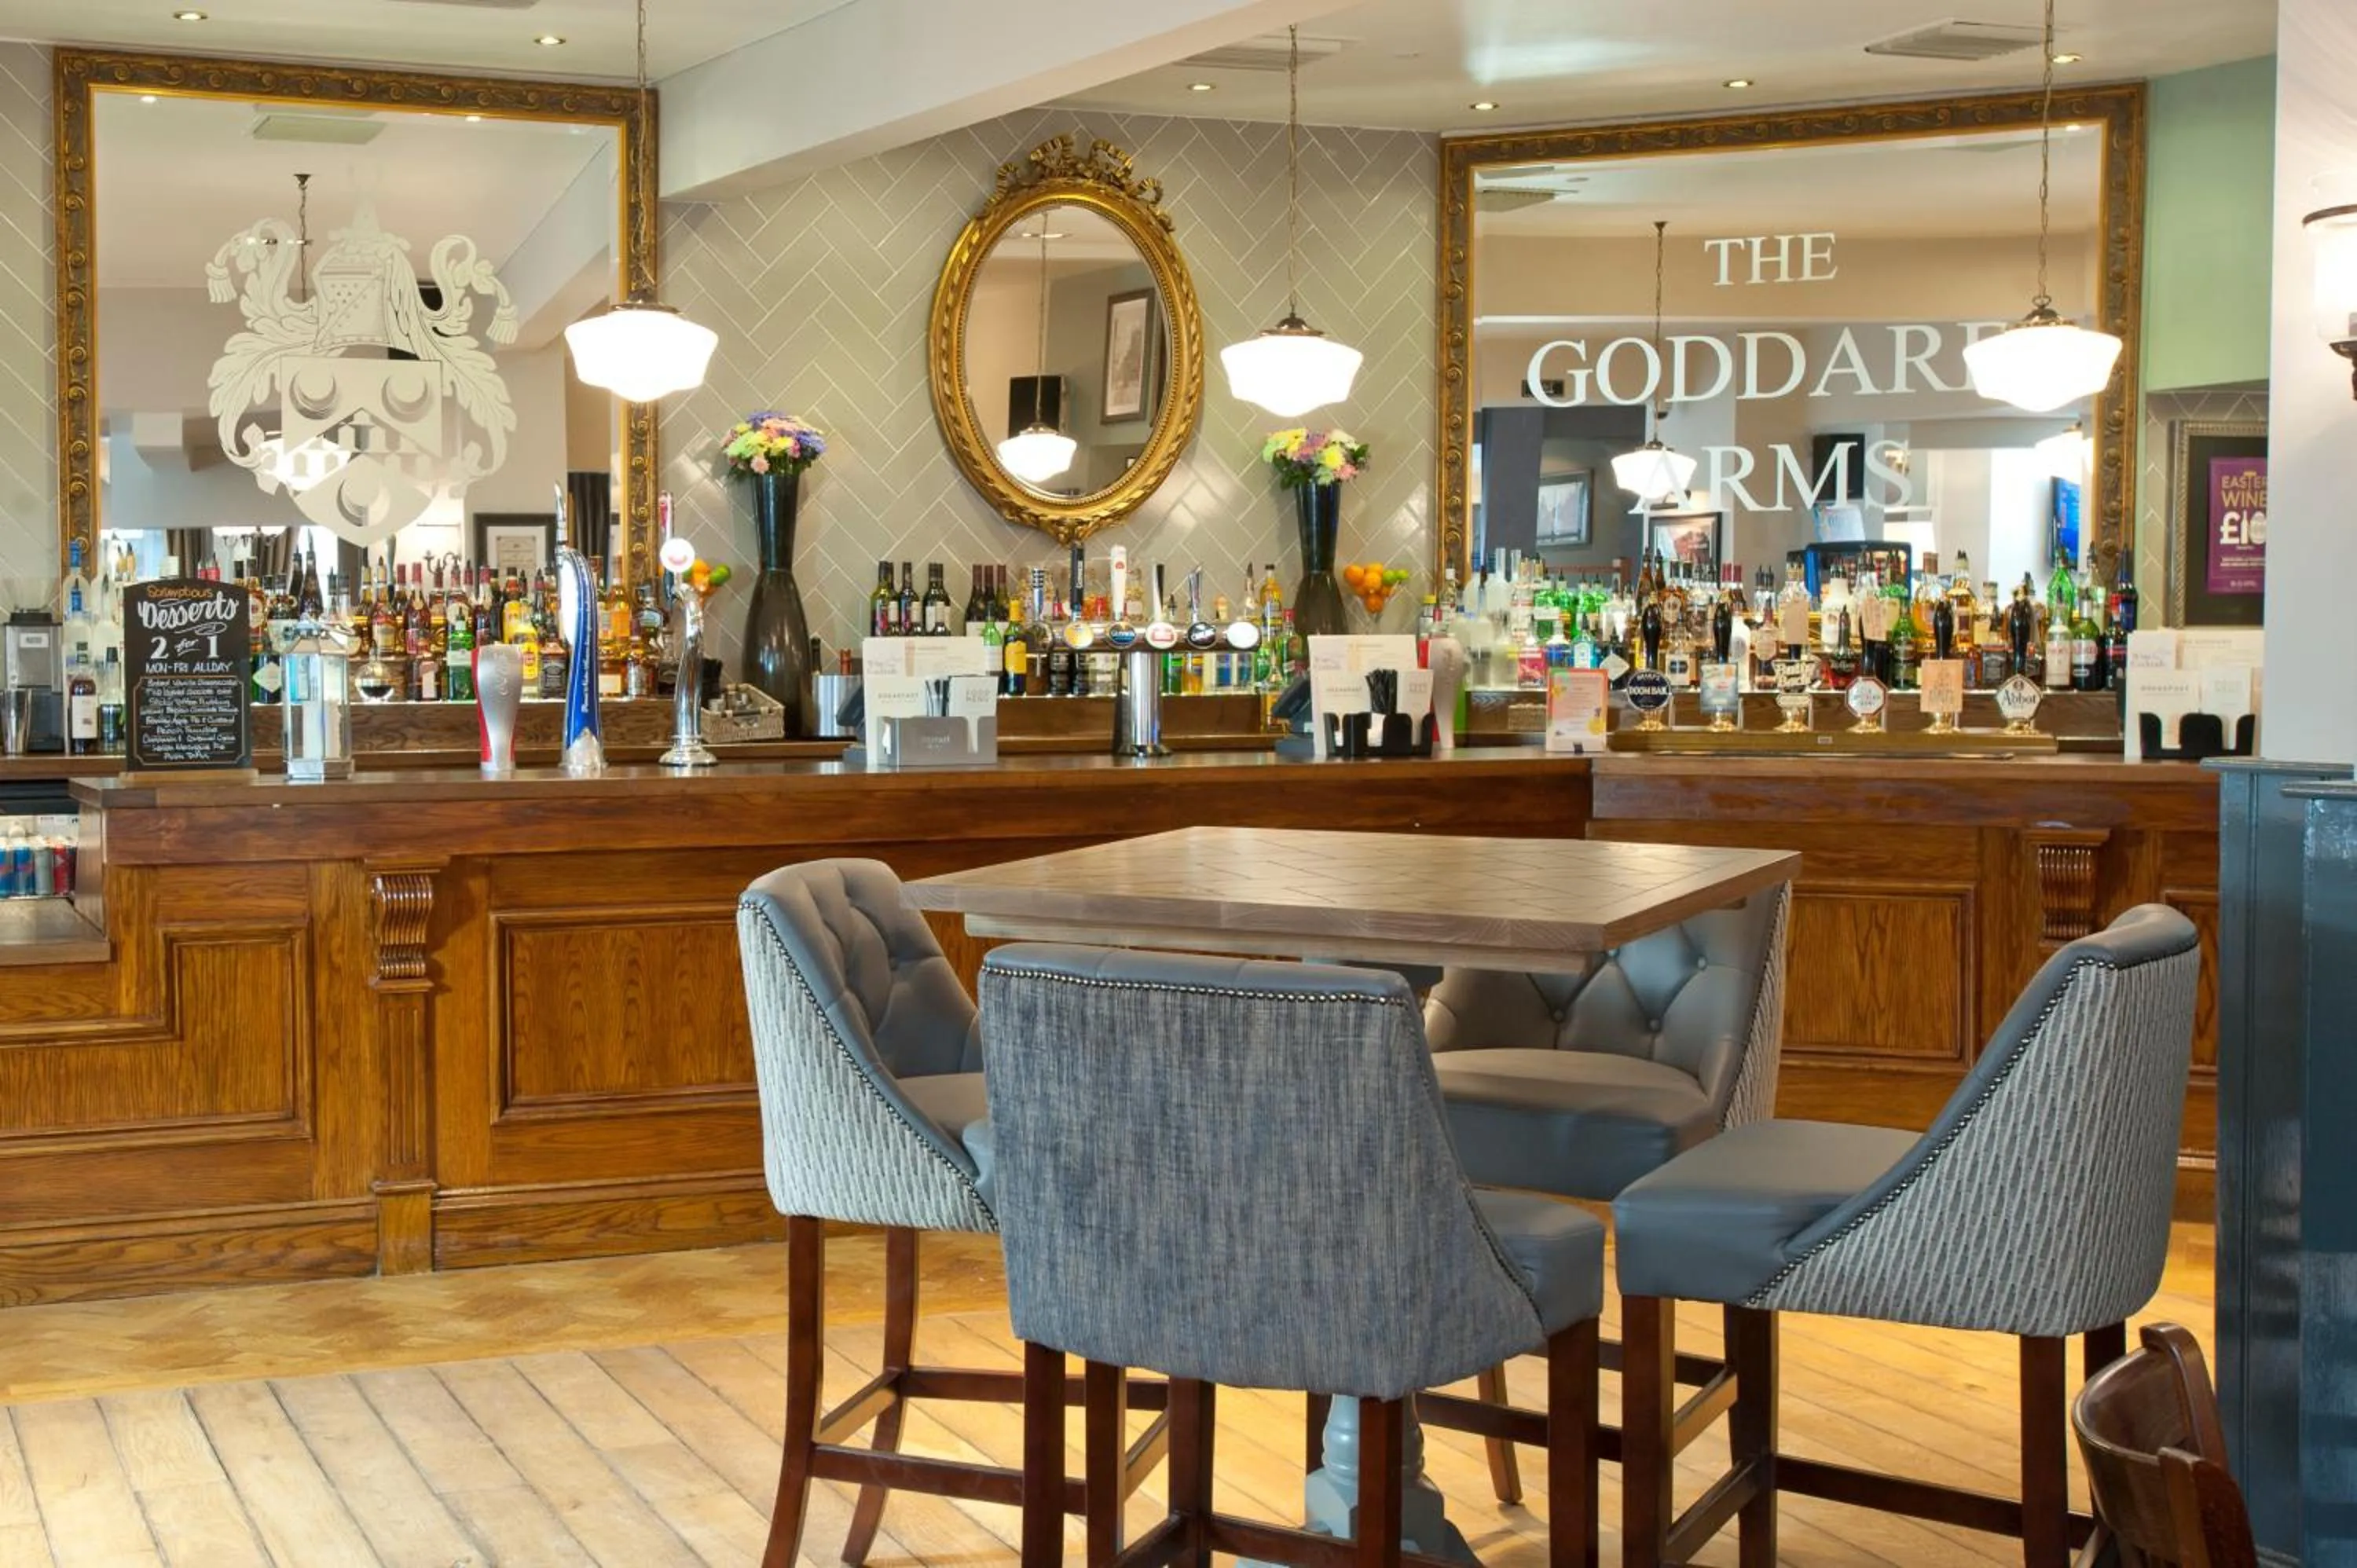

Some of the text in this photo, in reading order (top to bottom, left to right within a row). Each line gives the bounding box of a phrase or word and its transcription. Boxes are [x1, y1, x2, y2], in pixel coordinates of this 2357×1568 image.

[1703, 232, 1838, 286] THE
[1628, 439, 1914, 515] ARMS
[137, 590, 239, 630] Desserts
[150, 635, 220, 660] 2 for 1
